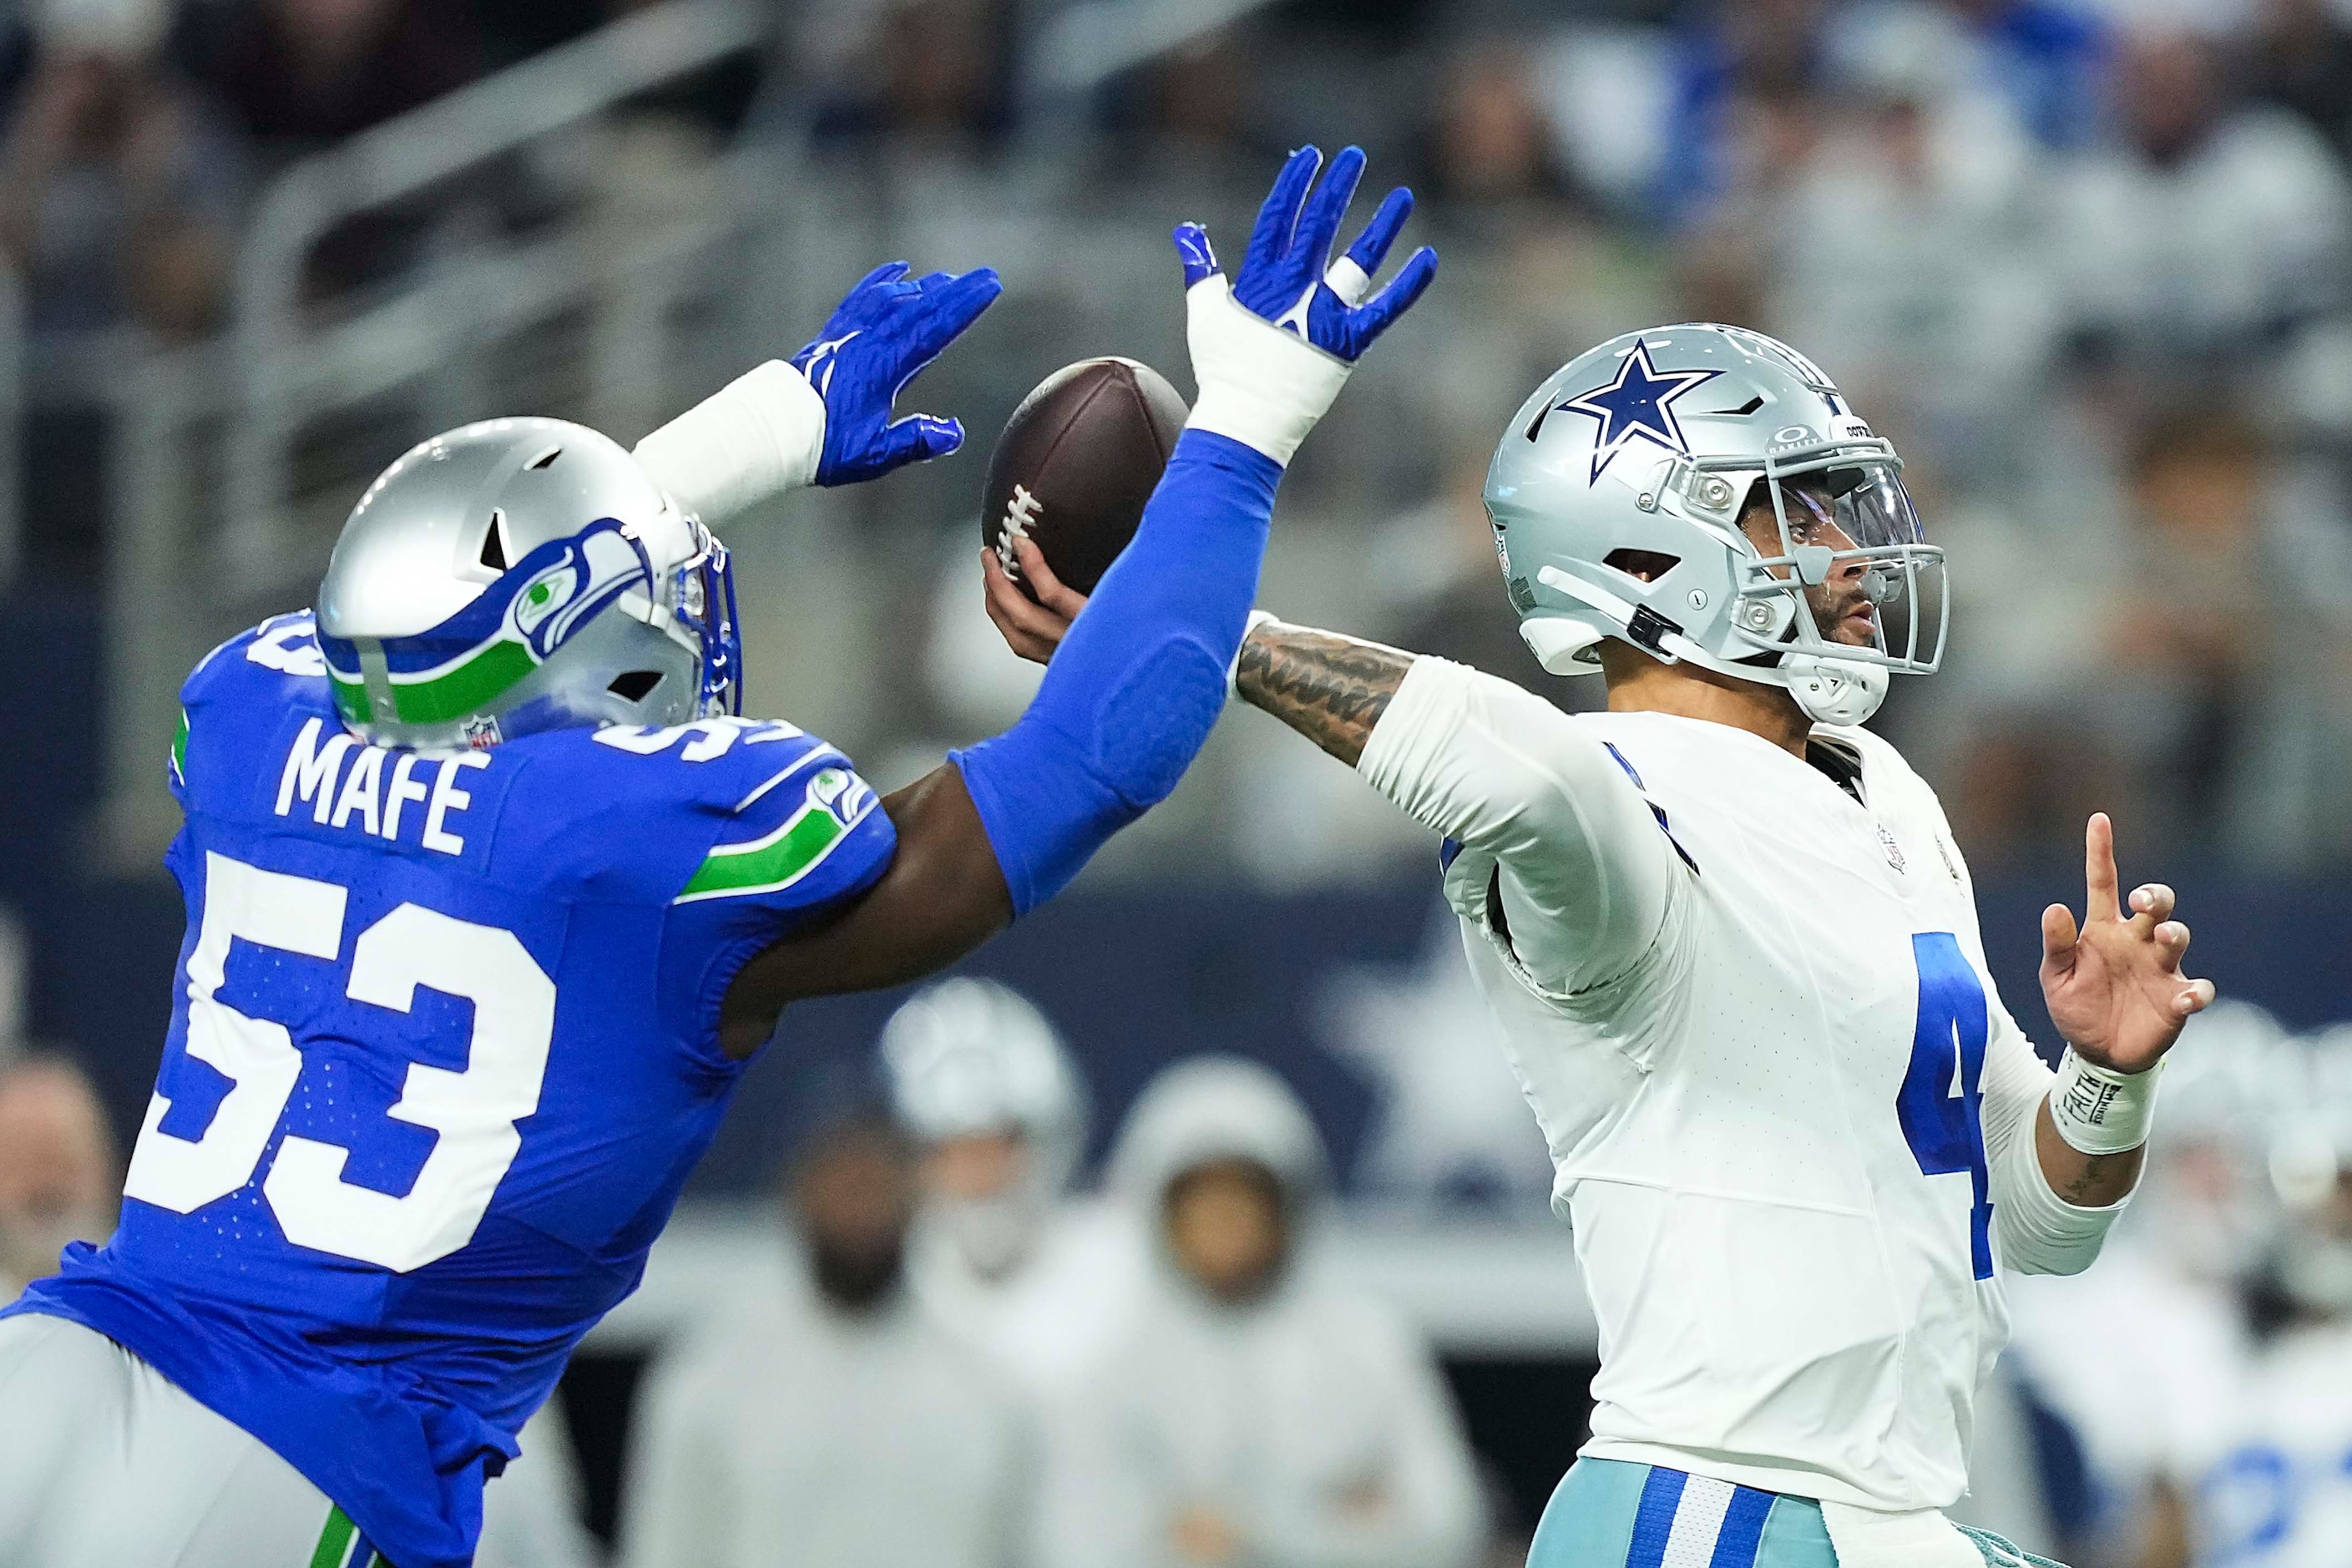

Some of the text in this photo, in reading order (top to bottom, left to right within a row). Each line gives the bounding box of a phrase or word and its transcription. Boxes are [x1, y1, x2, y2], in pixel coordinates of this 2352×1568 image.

[274, 716, 493, 857] MAFE
[123, 850, 557, 1274] 53
[1896, 931, 1995, 1282] 4
[2063, 1070, 2101, 1124] FAITH
